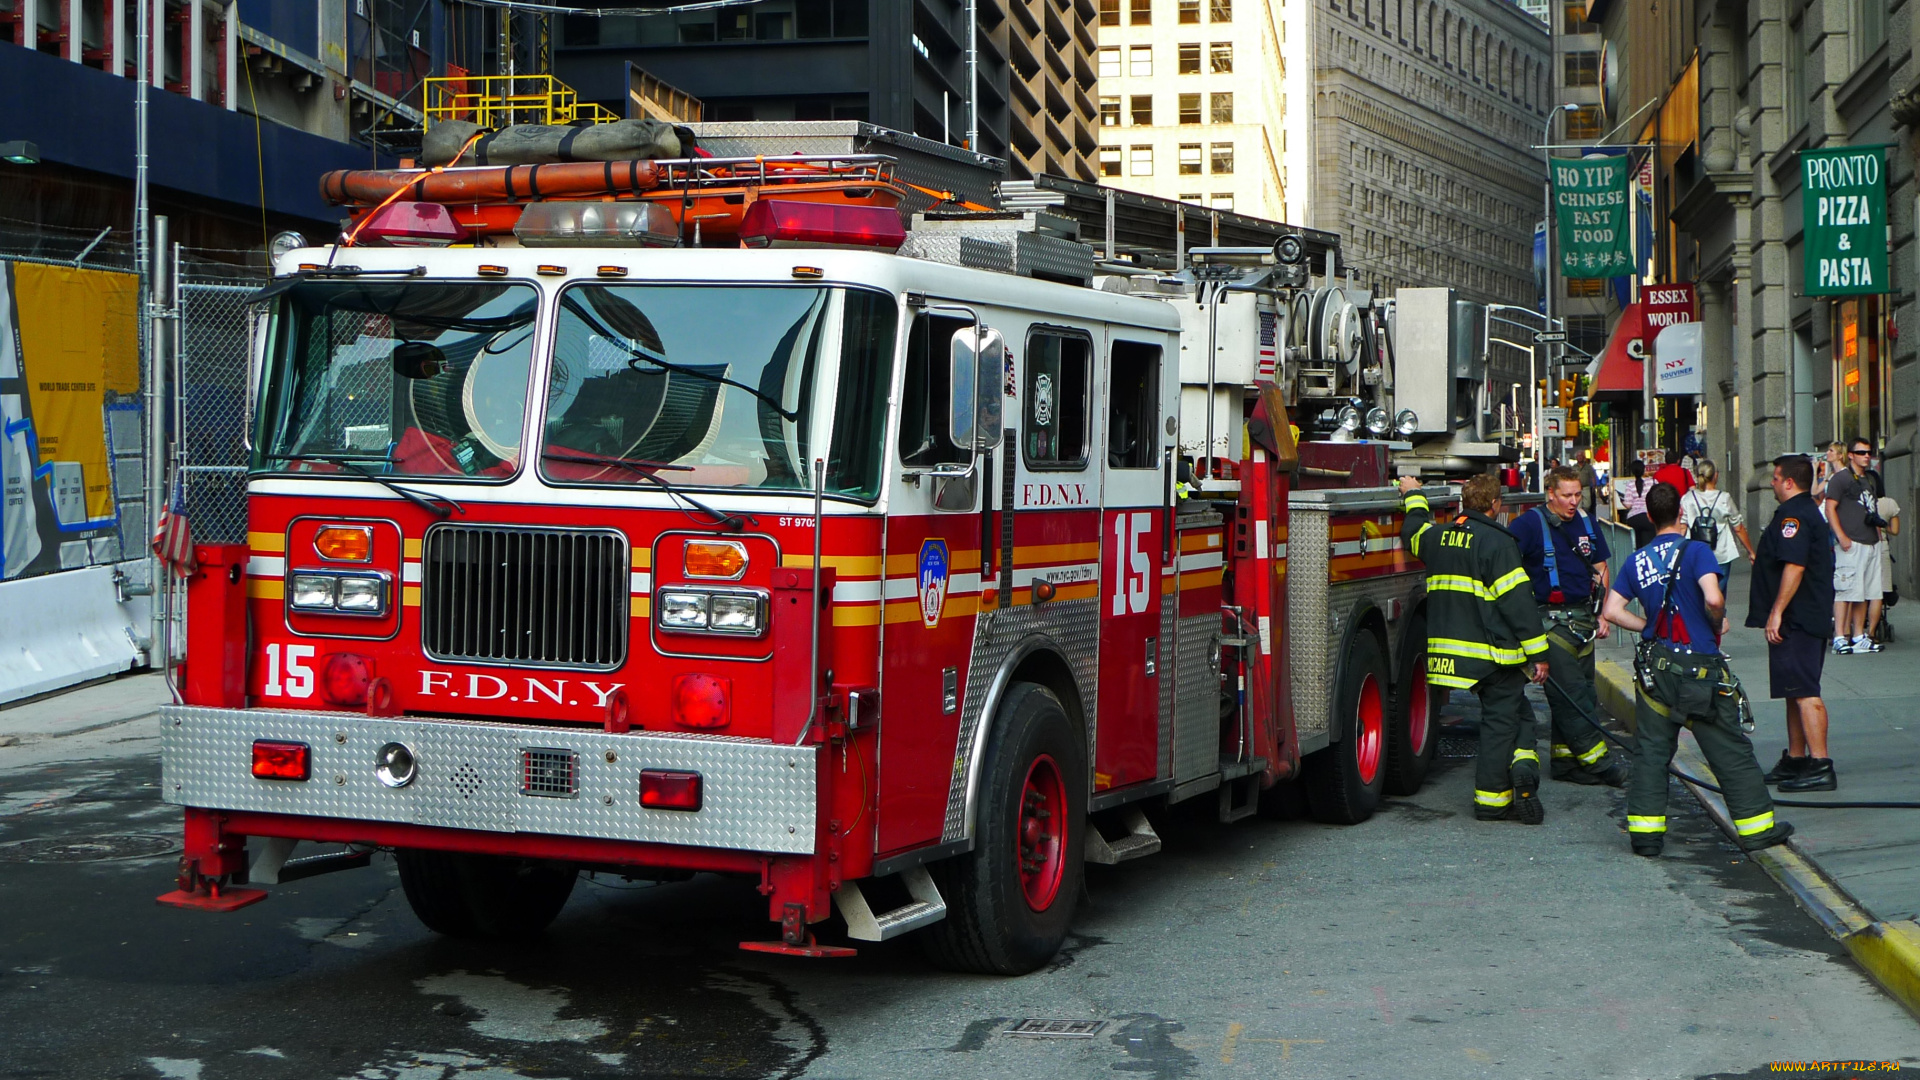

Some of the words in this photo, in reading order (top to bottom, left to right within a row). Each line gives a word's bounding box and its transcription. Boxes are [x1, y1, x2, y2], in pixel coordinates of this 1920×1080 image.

[1557, 167, 1579, 187] HO
[1584, 167, 1613, 187] YIP
[1807, 154, 1879, 190] PRONTO
[1559, 191, 1624, 207] CHINESE
[1574, 210, 1610, 225] FAST
[1819, 196, 1870, 226] PIZZA
[1573, 229, 1614, 243] FOOD
[1838, 233, 1851, 250] &
[1819, 257, 1872, 287] PASTA
[1649, 289, 1688, 304] ESSEX
[1648, 312, 1689, 327] WORLD
[1665, 359, 1686, 370] NY
[1660, 367, 1693, 379] SOUVINER
[1023, 484, 1089, 506] F.D.N.Y.
[779, 517, 792, 527] ST
[1113, 512, 1152, 616] 15
[265, 643, 315, 698] 15
